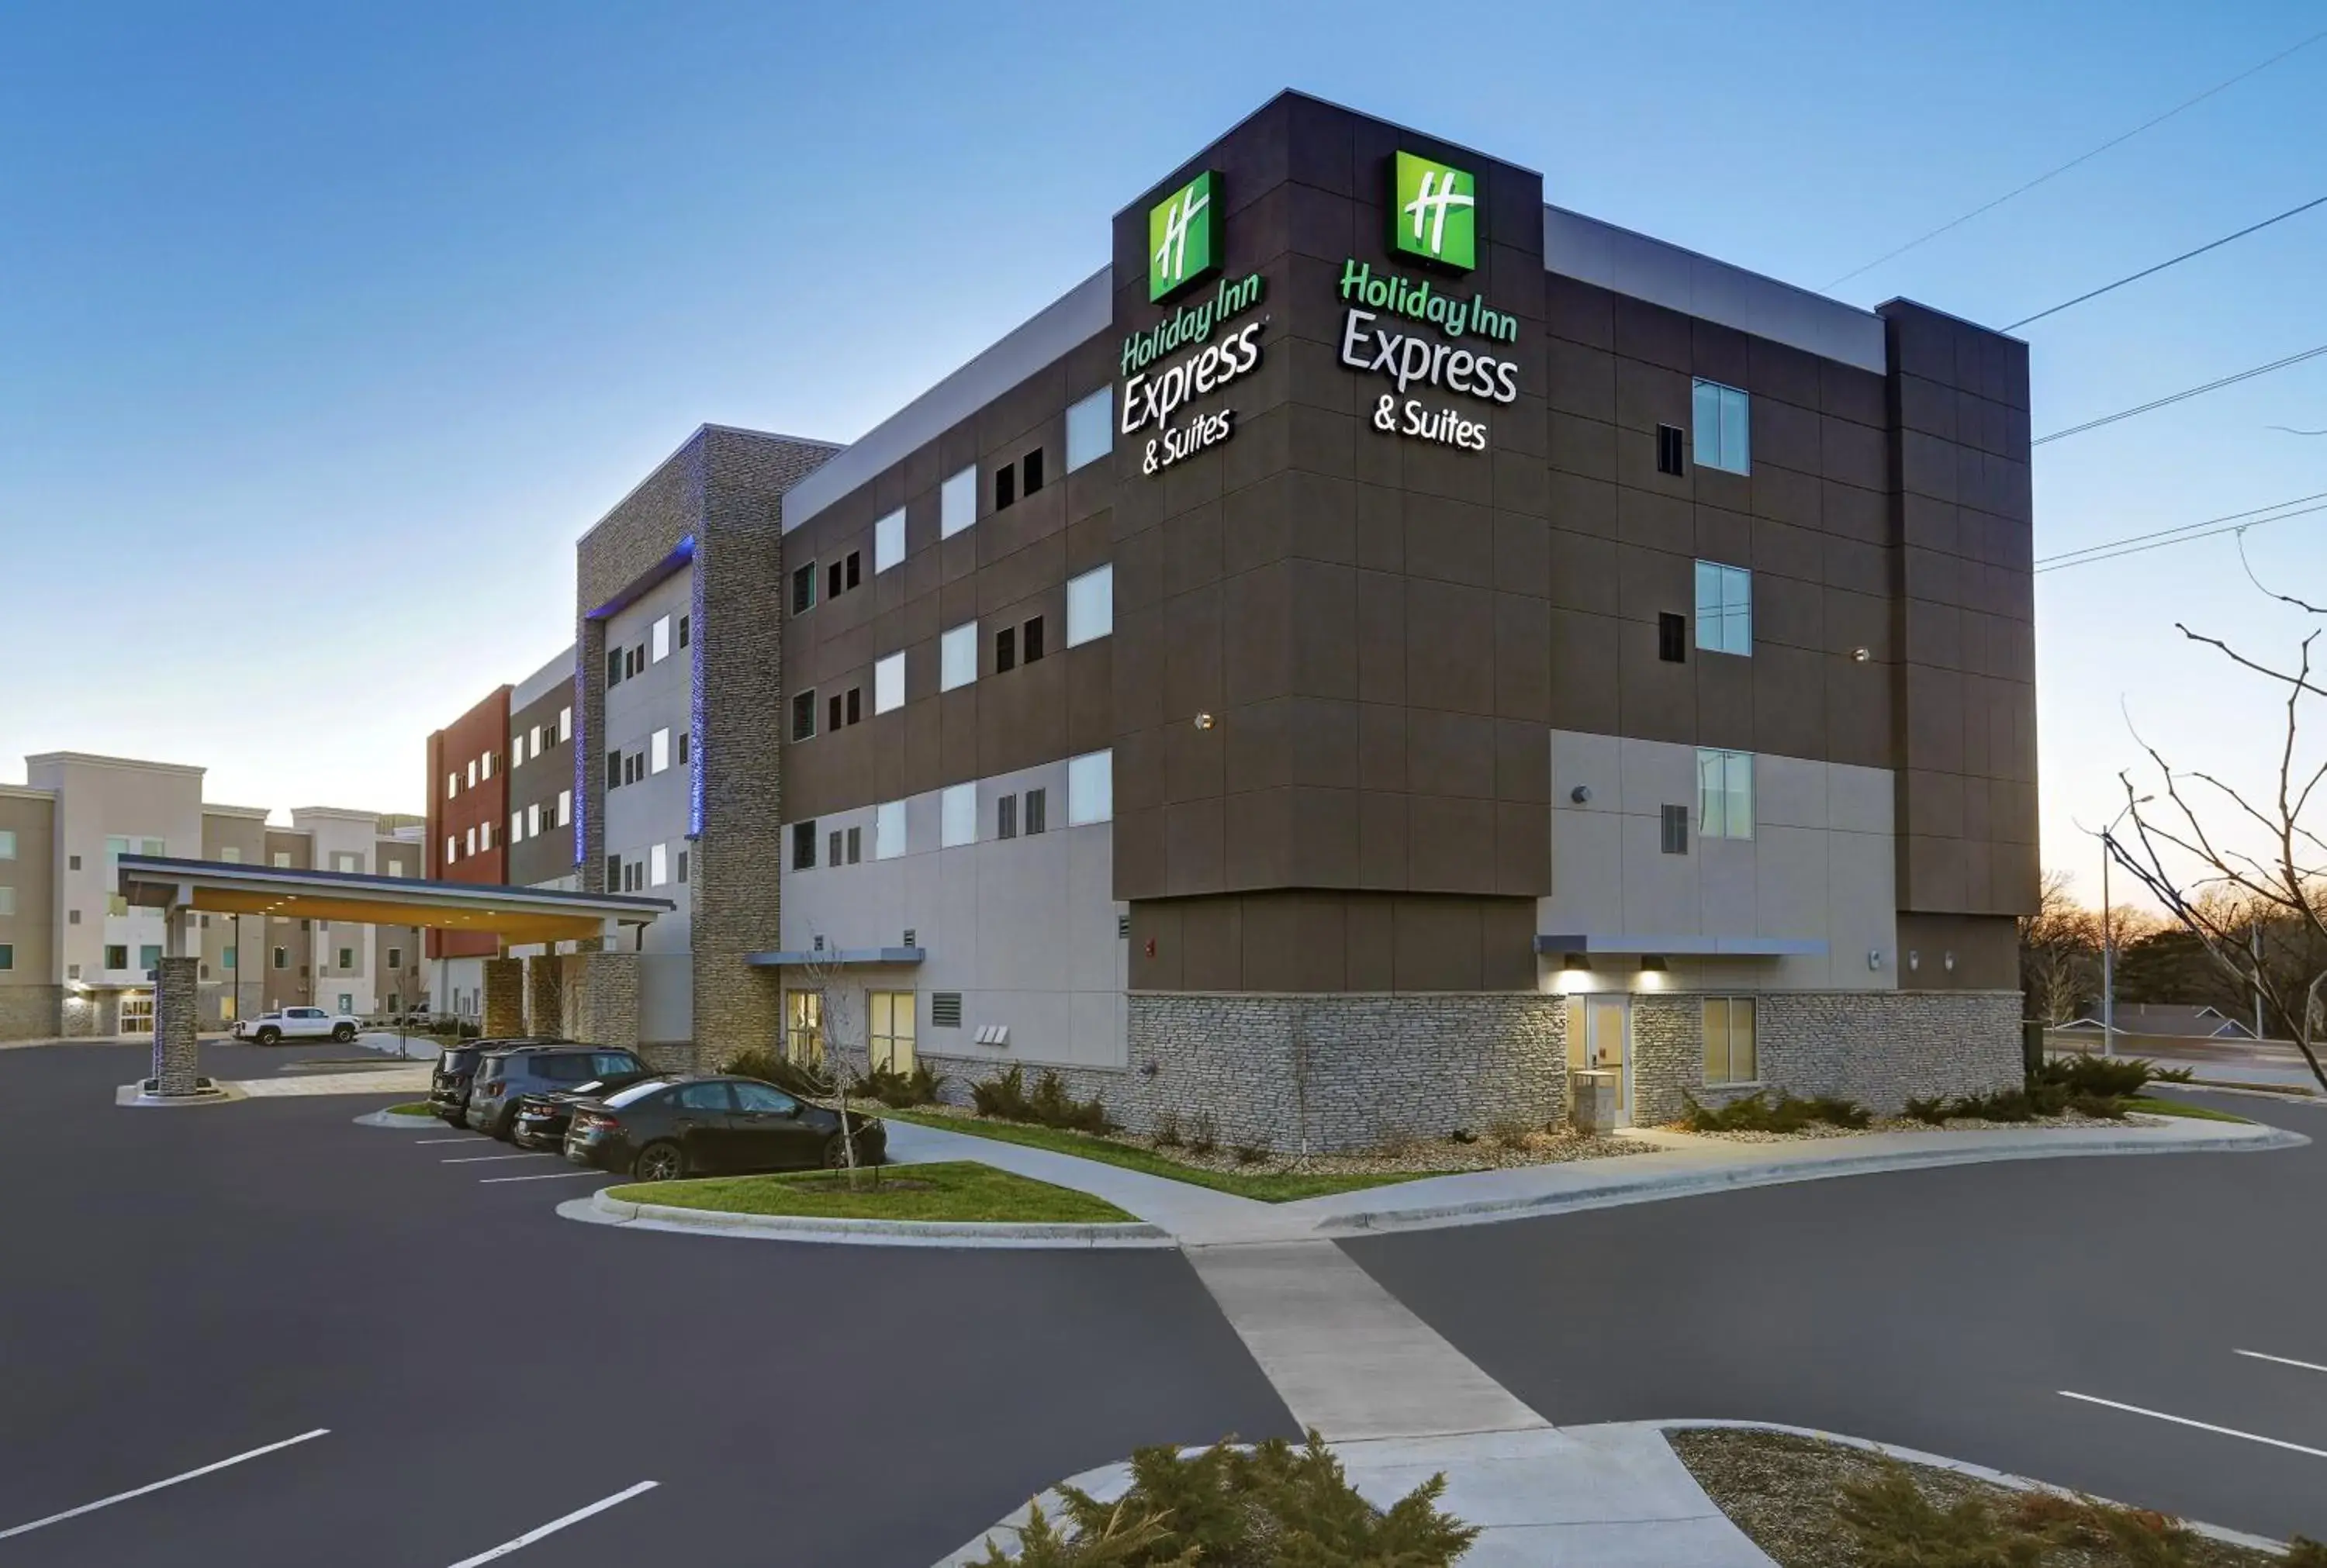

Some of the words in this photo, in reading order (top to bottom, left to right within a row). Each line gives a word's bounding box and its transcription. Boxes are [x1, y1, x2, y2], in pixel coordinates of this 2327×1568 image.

[1120, 300, 1213, 377] Holiday
[1216, 273, 1259, 322] Inn
[1340, 259, 1468, 337] Holiday
[1471, 294, 1517, 343] Inn
[1122, 323, 1260, 434] Express
[1343, 308, 1519, 403] Express
[1143, 438, 1159, 475] &
[1162, 409, 1230, 466] Suites
[1374, 394, 1396, 432] &
[1402, 400, 1487, 451] Suites
